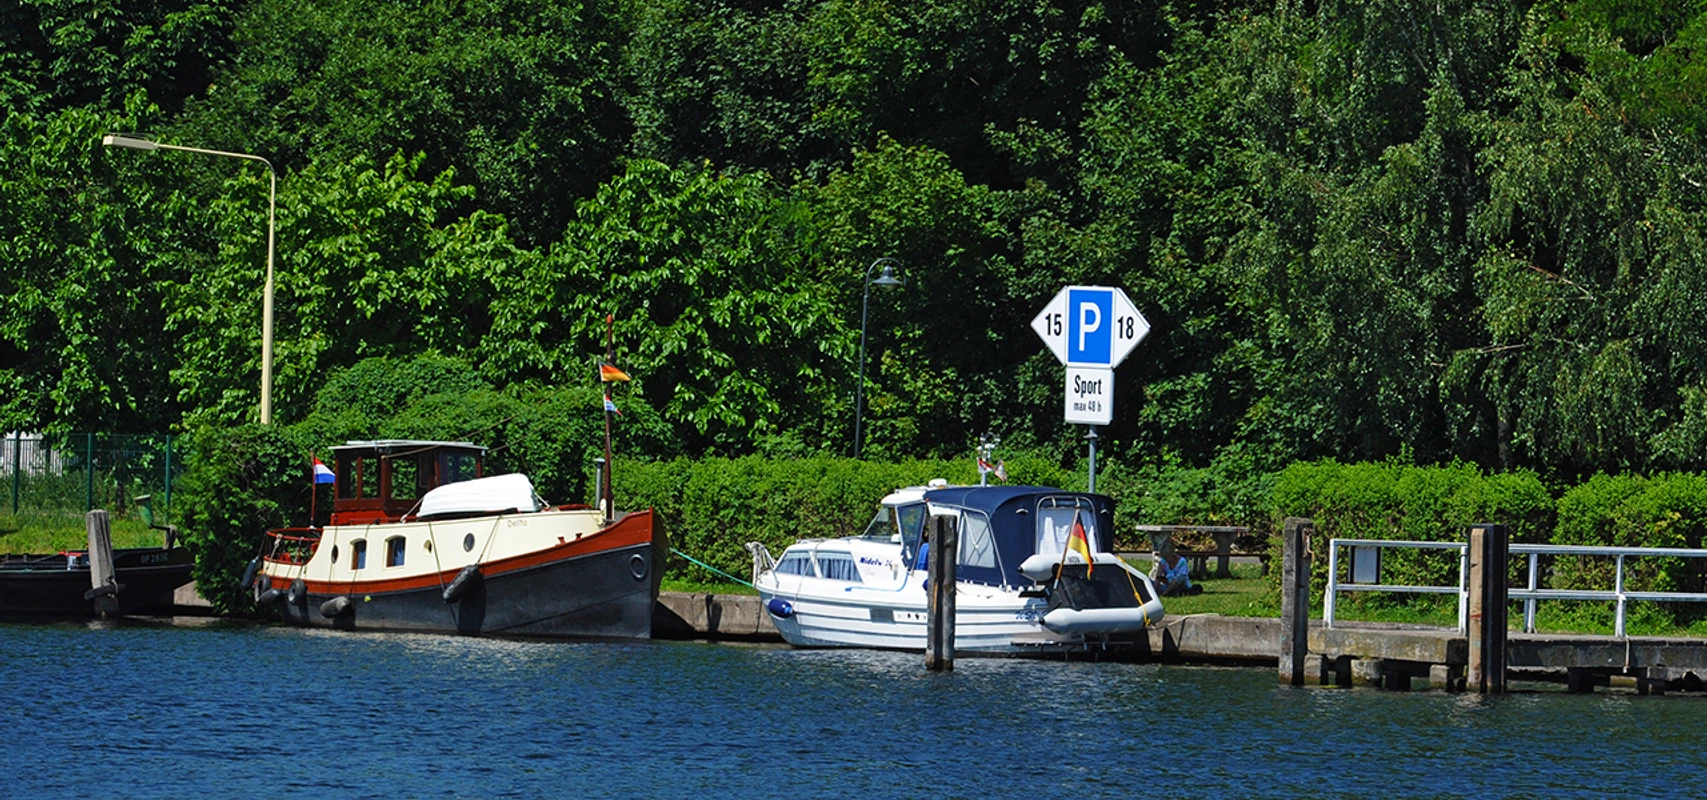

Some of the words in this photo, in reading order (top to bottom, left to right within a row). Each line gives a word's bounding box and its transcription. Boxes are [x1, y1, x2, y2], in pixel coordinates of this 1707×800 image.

[1045, 313, 1062, 336] 15
[1079, 302, 1101, 351] P
[1117, 316, 1135, 340] 18
[1074, 374, 1102, 398] Sport
[1073, 401, 1086, 411] max
[1088, 401, 1096, 412] 48
[1097, 401, 1102, 412] h
